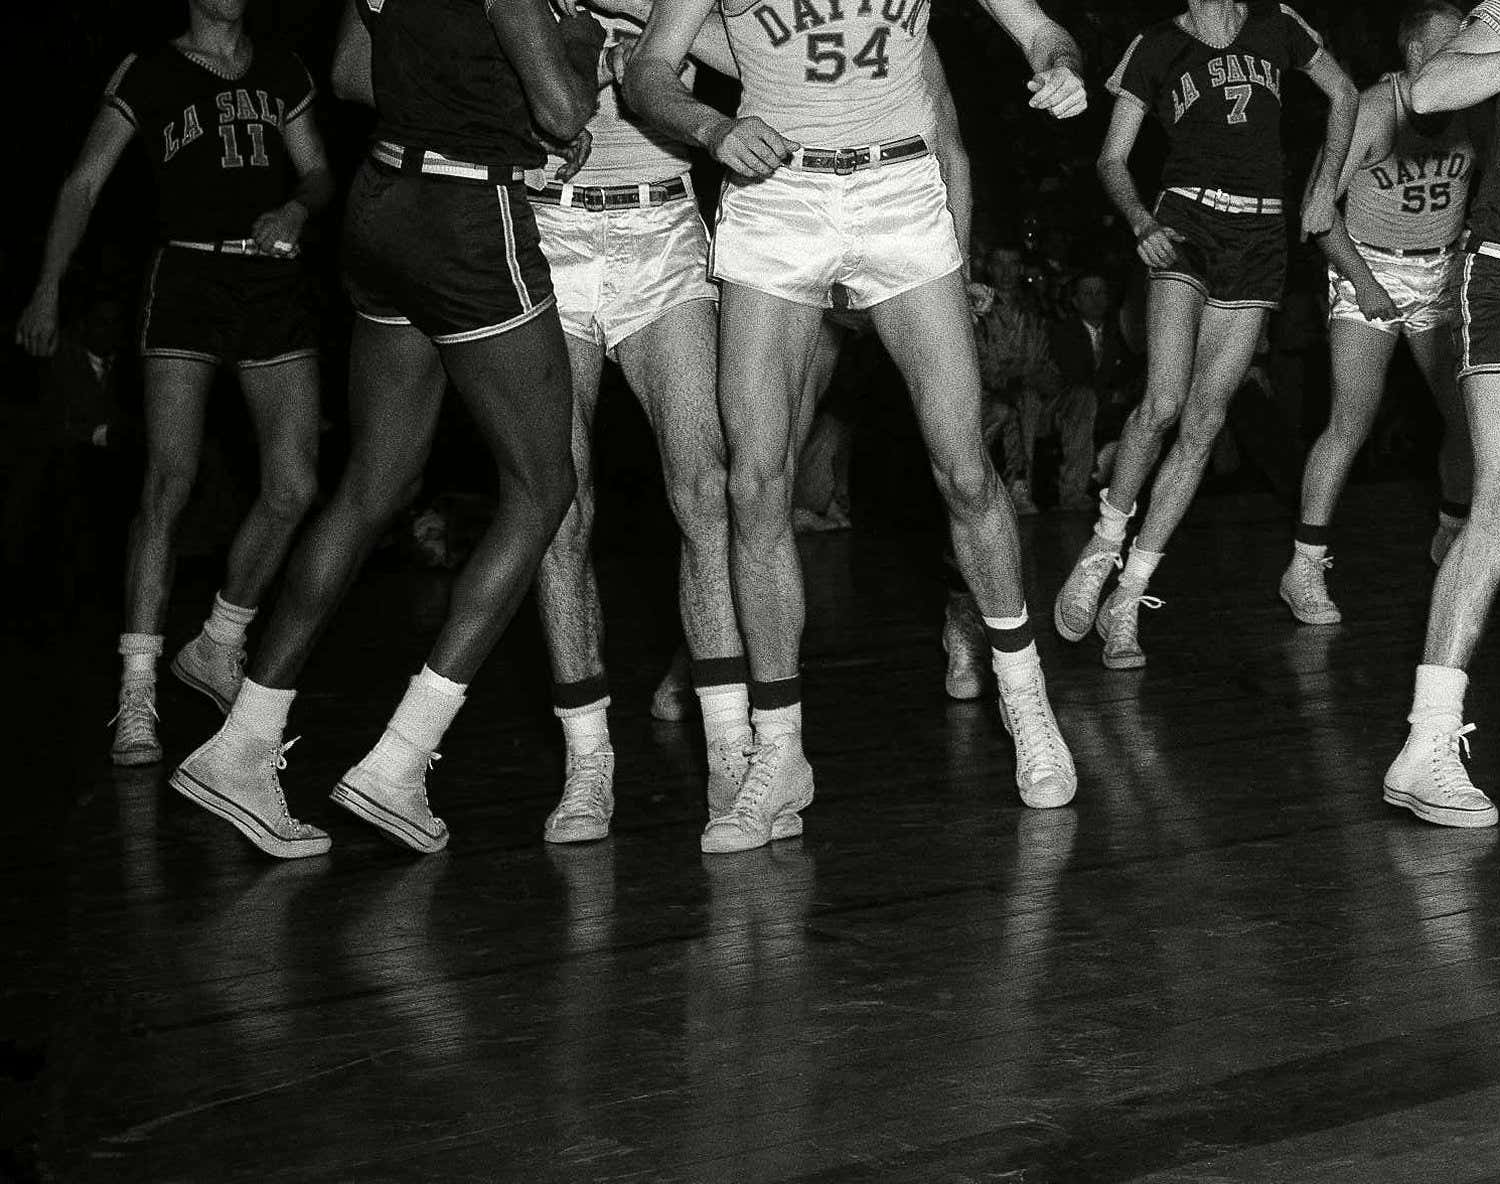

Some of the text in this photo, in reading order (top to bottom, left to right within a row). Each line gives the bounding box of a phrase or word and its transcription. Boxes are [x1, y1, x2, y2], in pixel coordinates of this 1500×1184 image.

[804, 27, 891, 83] 54
[1172, 55, 1282, 124] LA SALL
[1224, 84, 1252, 124] 7
[163, 103, 204, 162] LA
[219, 124, 269, 168] 11
[1371, 152, 1469, 190] DAYTO
[1401, 183, 1450, 213] 55
